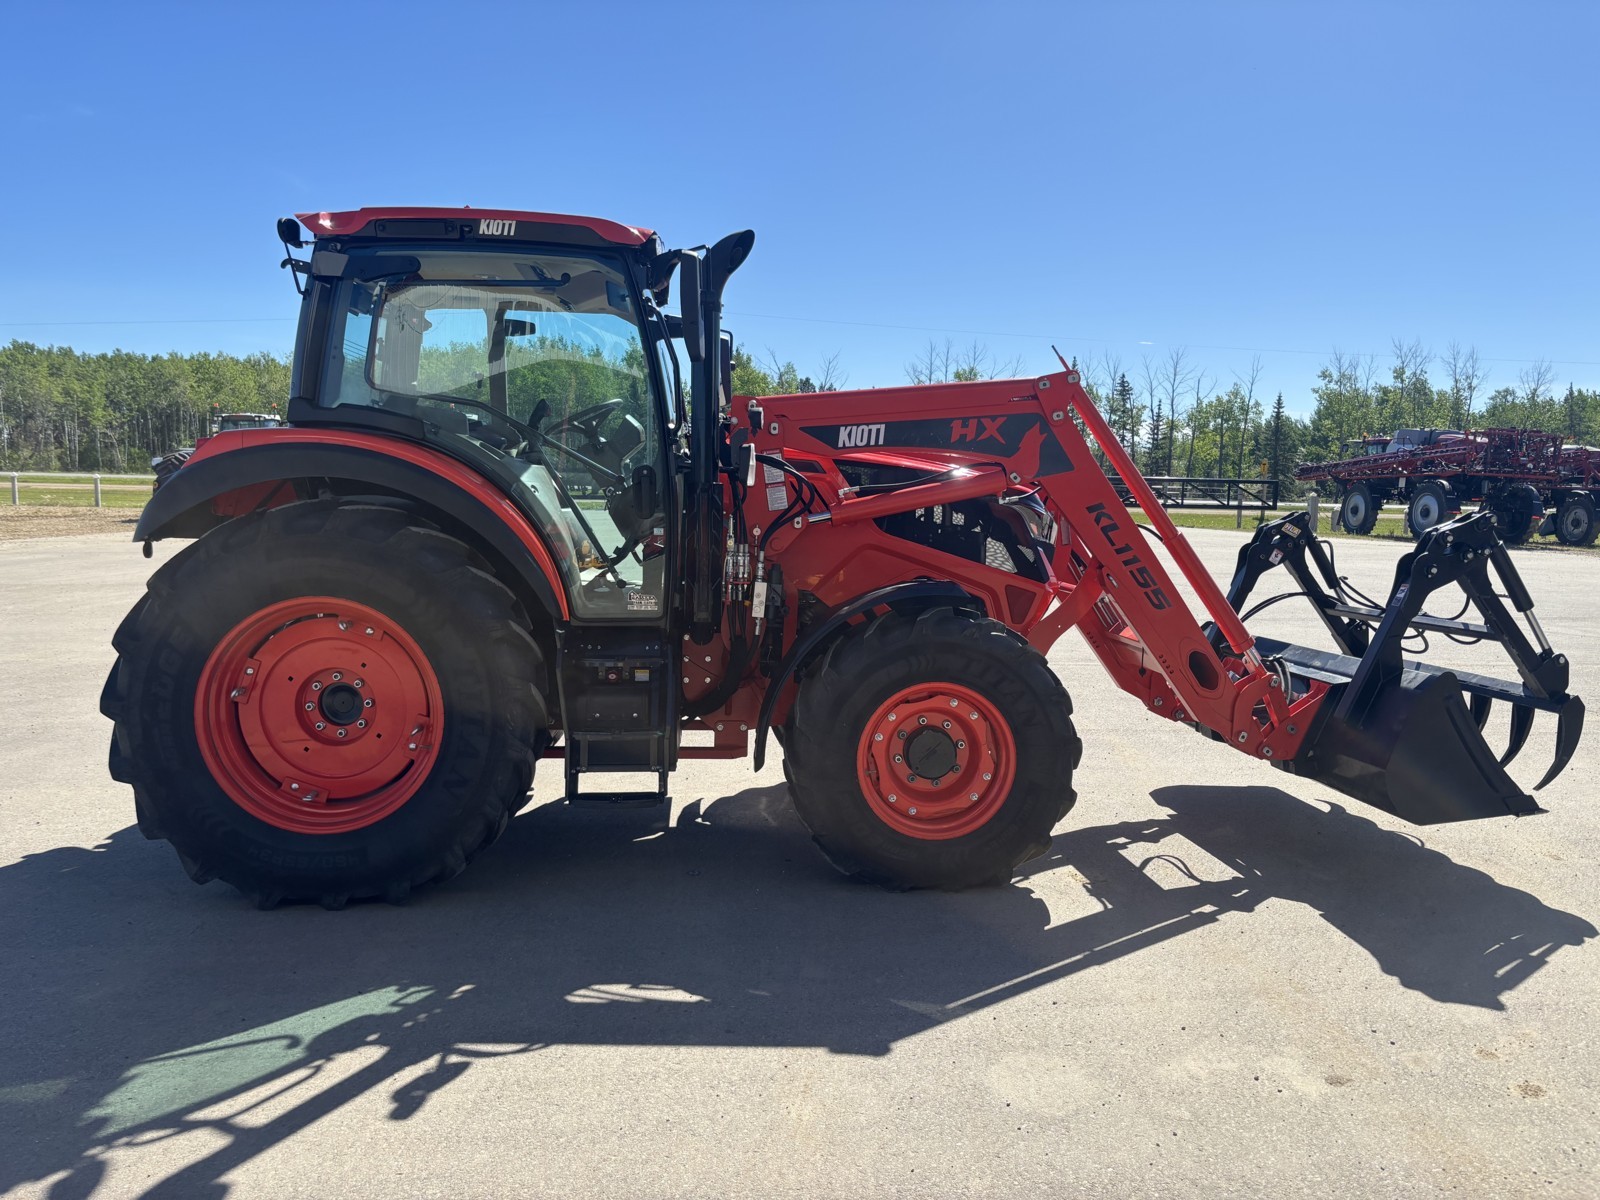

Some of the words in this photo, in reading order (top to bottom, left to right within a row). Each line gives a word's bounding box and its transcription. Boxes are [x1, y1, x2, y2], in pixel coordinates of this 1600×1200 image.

[479, 219, 516, 235] KIOTI
[838, 424, 885, 447] KIOTI
[950, 417, 1007, 444] HX
[1086, 502, 1173, 610] KL1155
[960, 656, 1046, 728] TITAN
